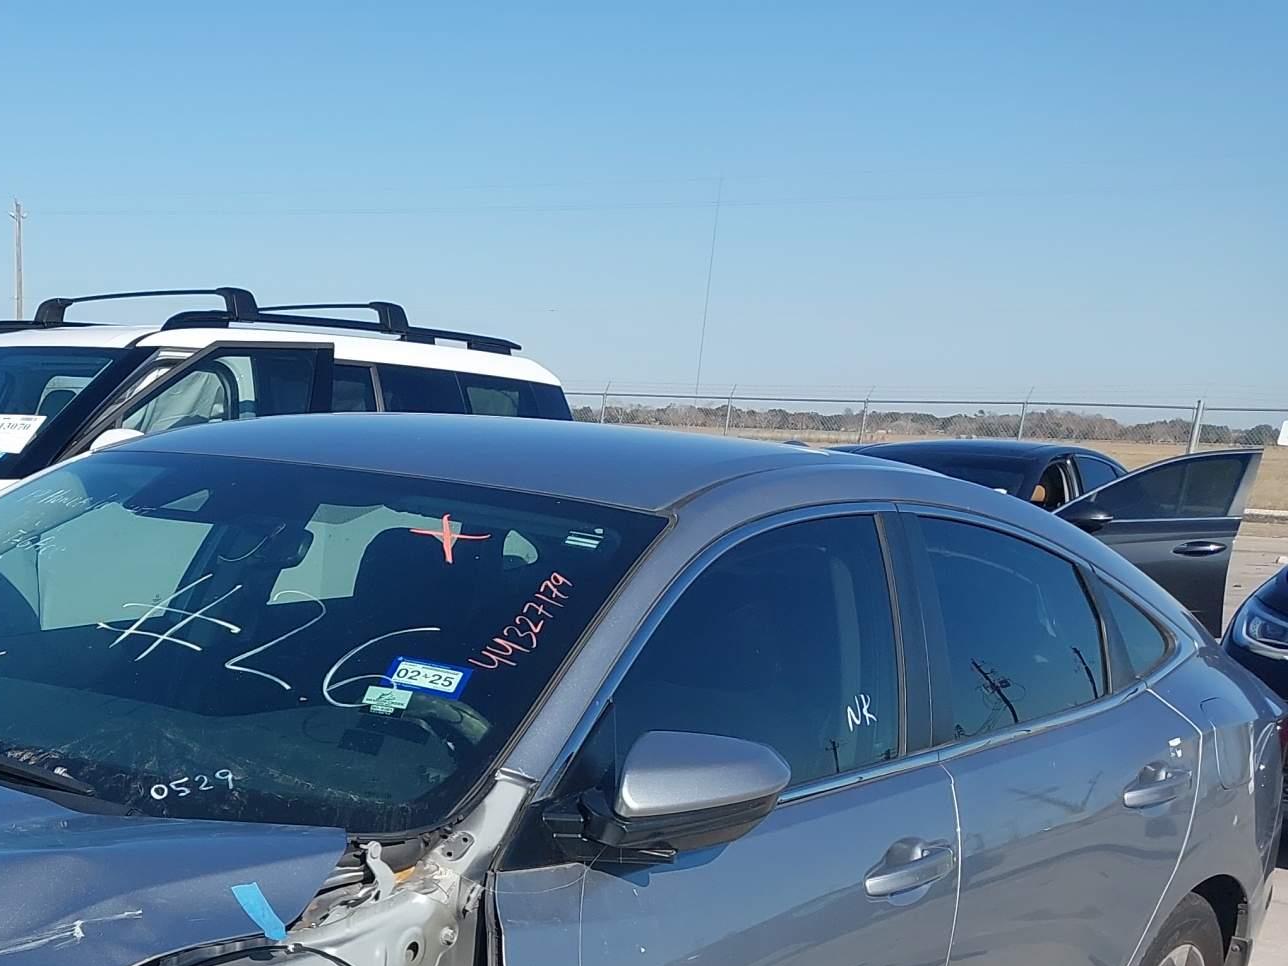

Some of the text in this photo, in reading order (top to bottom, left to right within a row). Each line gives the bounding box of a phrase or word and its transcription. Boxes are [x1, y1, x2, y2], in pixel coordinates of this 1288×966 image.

[96, 573, 441, 708] #26
[467, 571, 574, 669] 44327179
[150, 768, 236, 800] 0529
